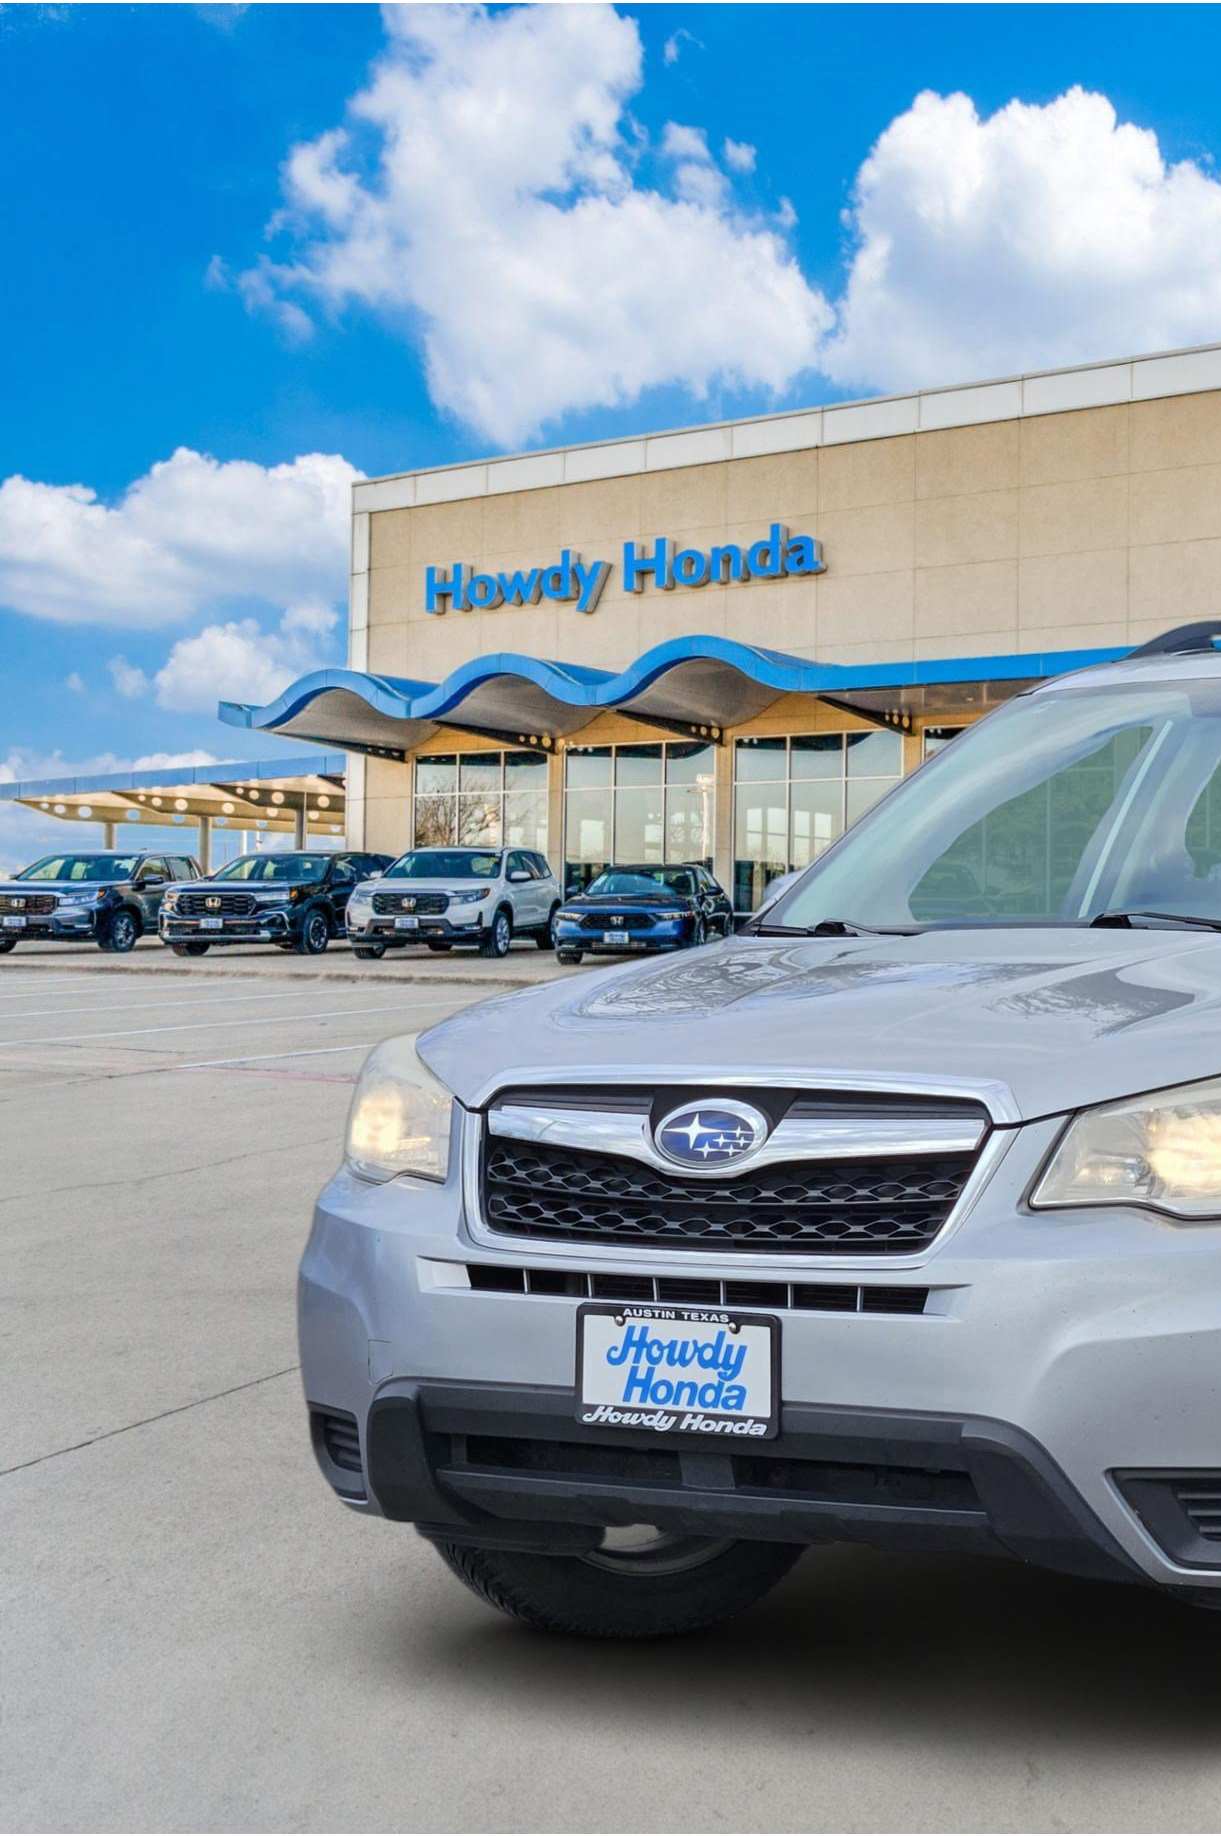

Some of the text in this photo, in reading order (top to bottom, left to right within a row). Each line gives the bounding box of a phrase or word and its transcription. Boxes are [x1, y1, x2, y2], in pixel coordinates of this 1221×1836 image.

[424, 523, 827, 615] Howdy Honda
[622, 1307, 730, 1323] AUSTIN TEXAS
[606, 1325, 748, 1382] Howdy
[622, 1365, 748, 1411] Honda
[582, 1405, 768, 1436] Howdy Honda
